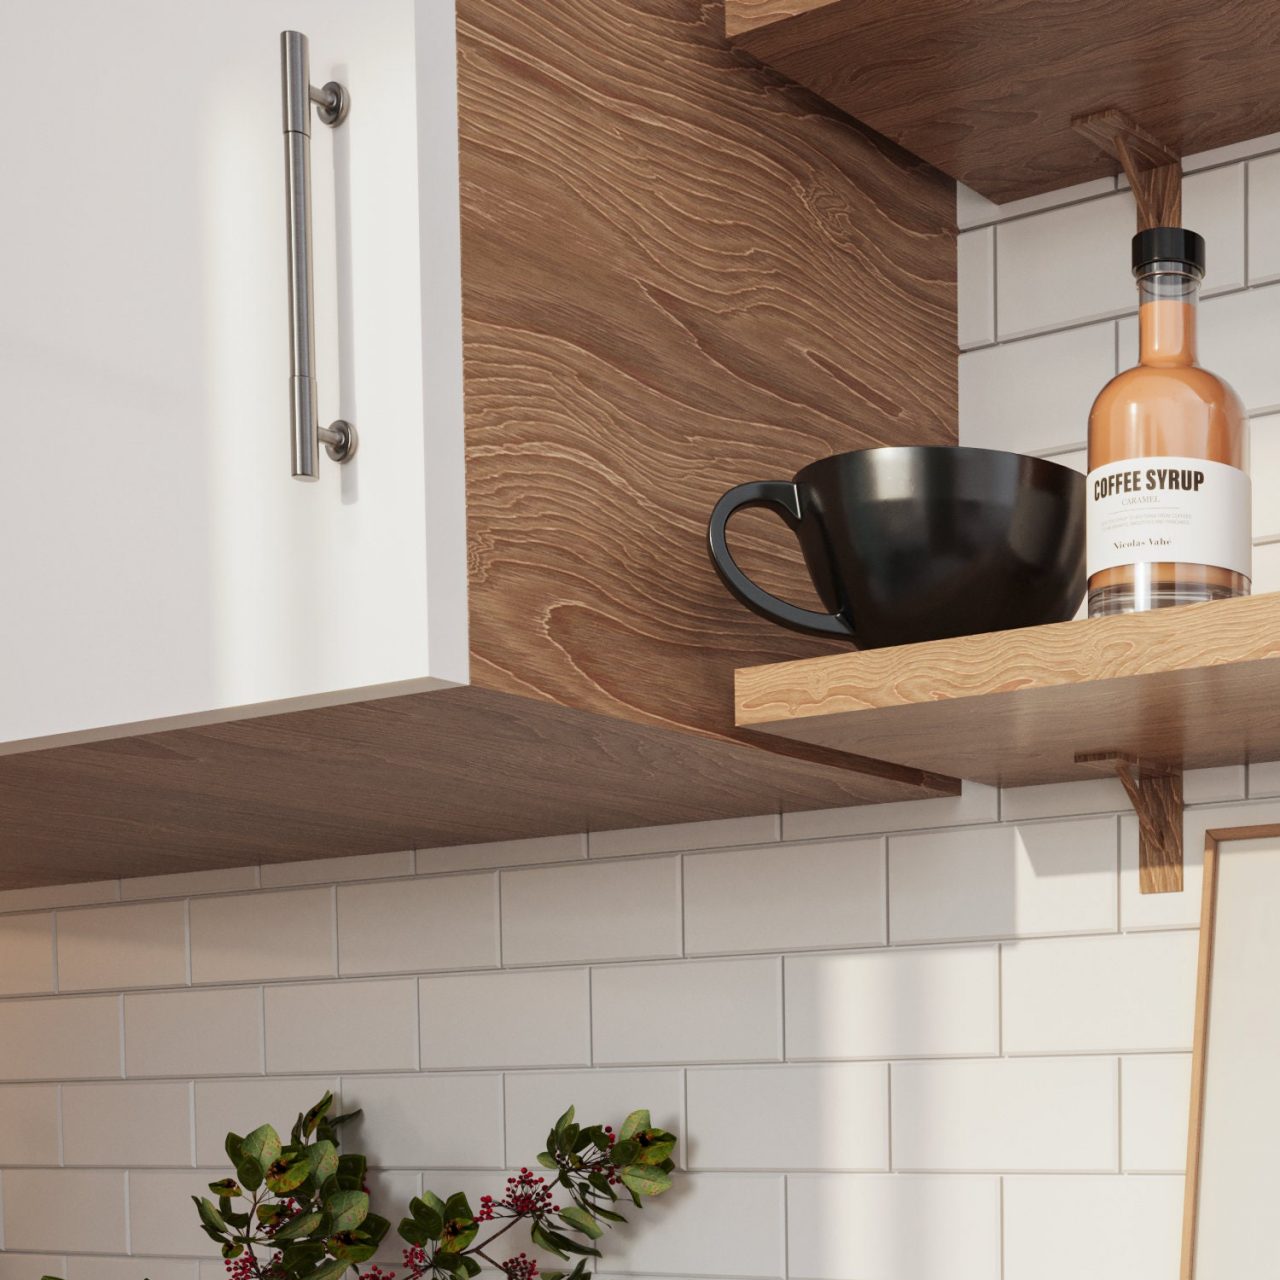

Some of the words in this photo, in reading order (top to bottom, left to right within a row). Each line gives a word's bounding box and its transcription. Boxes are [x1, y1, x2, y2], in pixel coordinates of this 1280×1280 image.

[1094, 471, 1141, 501] COFFEE
[1145, 469, 1204, 491] SYRUP
[1113, 539, 1146, 550] Nicolas
